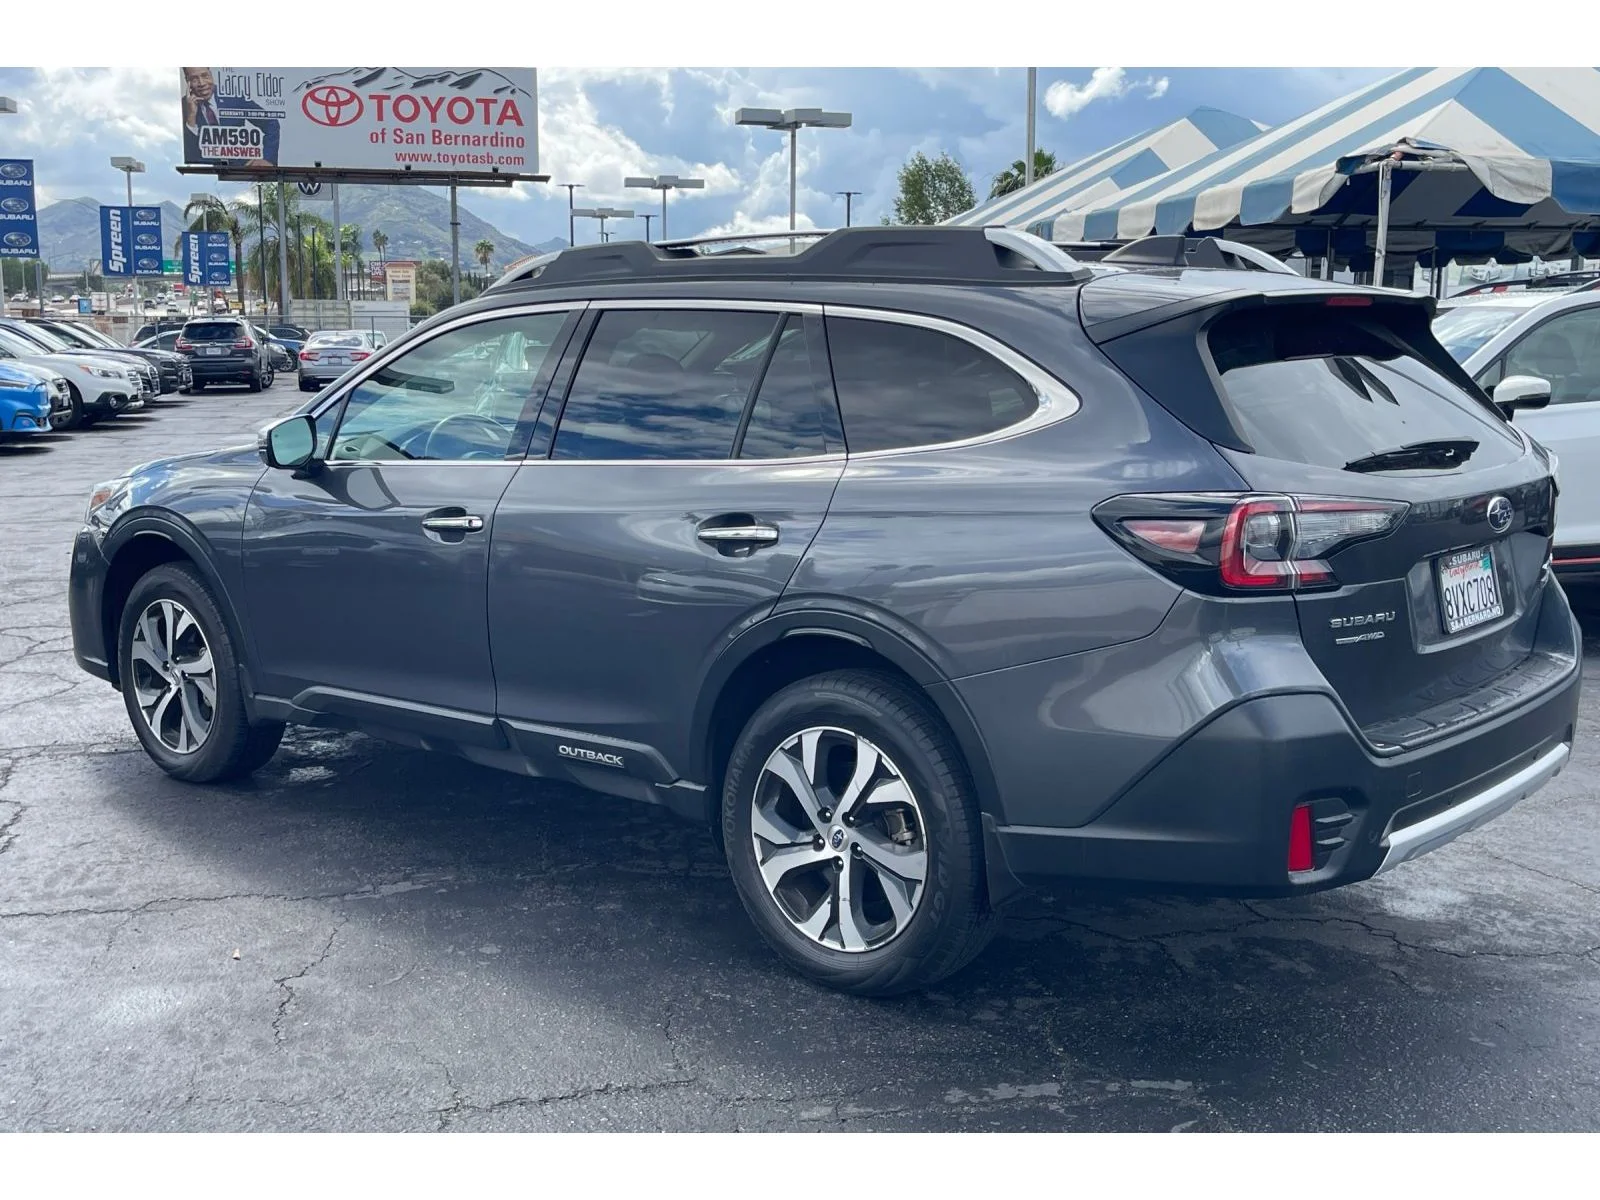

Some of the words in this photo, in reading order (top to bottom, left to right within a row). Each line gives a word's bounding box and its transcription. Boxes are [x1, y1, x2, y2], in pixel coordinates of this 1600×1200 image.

[218, 71, 251, 100] Larry
[256, 73, 285, 98] Elder
[368, 94, 524, 127] TOYOTA
[201, 128, 260, 146] AM590
[370, 128, 386, 144] of
[393, 128, 425, 146] San
[431, 129, 525, 149] Bernardino
[202, 146, 220, 157] THE
[220, 146, 261, 158] ANSWER
[395, 150, 525, 166] www.toyotasb.com
[109, 208, 127, 273] Spreen
[189, 233, 203, 284] Spreen
[1451, 550, 1481, 565] SUBARU
[1444, 575, 1495, 619] 8VXC708
[1330, 611, 1396, 628] SUBARU
[1357, 631, 1385, 641] AWD
[559, 745, 623, 766] OUTBACK
[725, 740, 754, 843] YOKOHAMA
